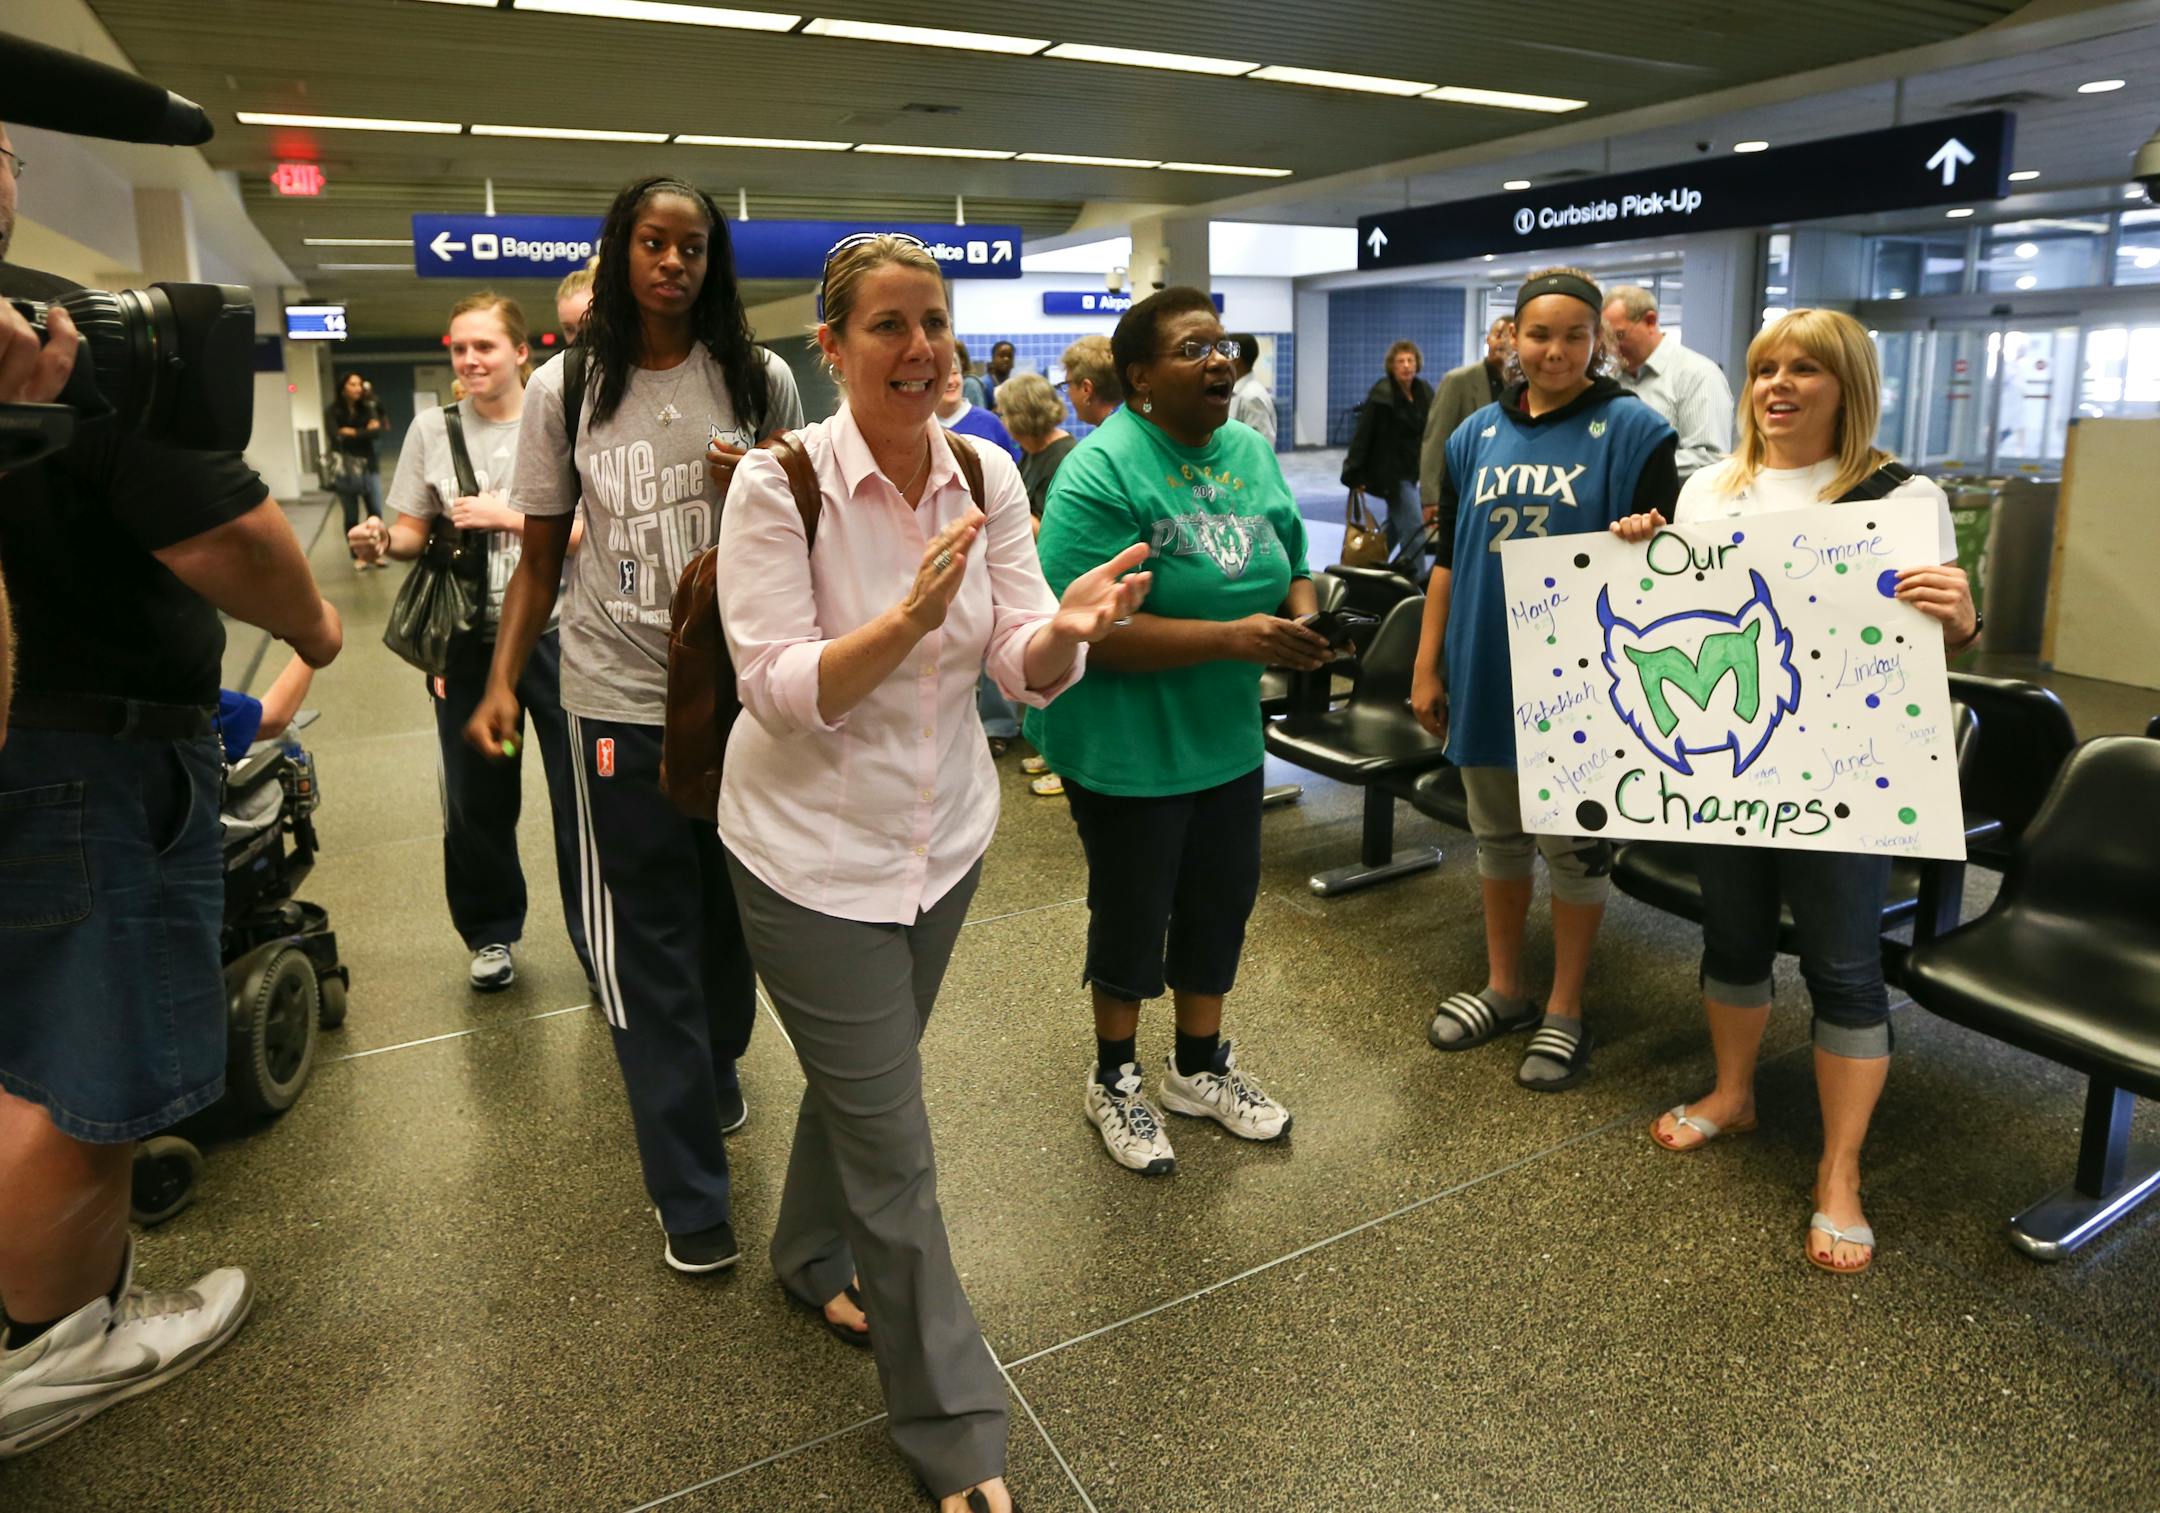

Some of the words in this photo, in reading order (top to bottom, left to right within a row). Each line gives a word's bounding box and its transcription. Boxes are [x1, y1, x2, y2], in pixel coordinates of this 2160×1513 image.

[277, 164, 320, 195] EXIT
[1538, 200, 1618, 229] Curbside
[1621, 187, 1702, 217] Pick-Up
[501, 237, 592, 262] Baggage
[323, 314, 347, 331] 14
[1099, 296, 1132, 311] Airpo
[589, 440, 657, 516] We
[1474, 464, 1587, 508] LYNX
[627, 500, 719, 606] FIR
[1646, 531, 1738, 575] Our
[1785, 534, 1895, 580] Simone
[604, 600, 638, 624] 2013
[1511, 593, 1569, 637] Maya
[1517, 681, 1602, 735] Rebekkah
[1553, 743, 1617, 794] Monica
[1811, 737, 1884, 791] Janel
[1615, 768, 1832, 837] Champs
